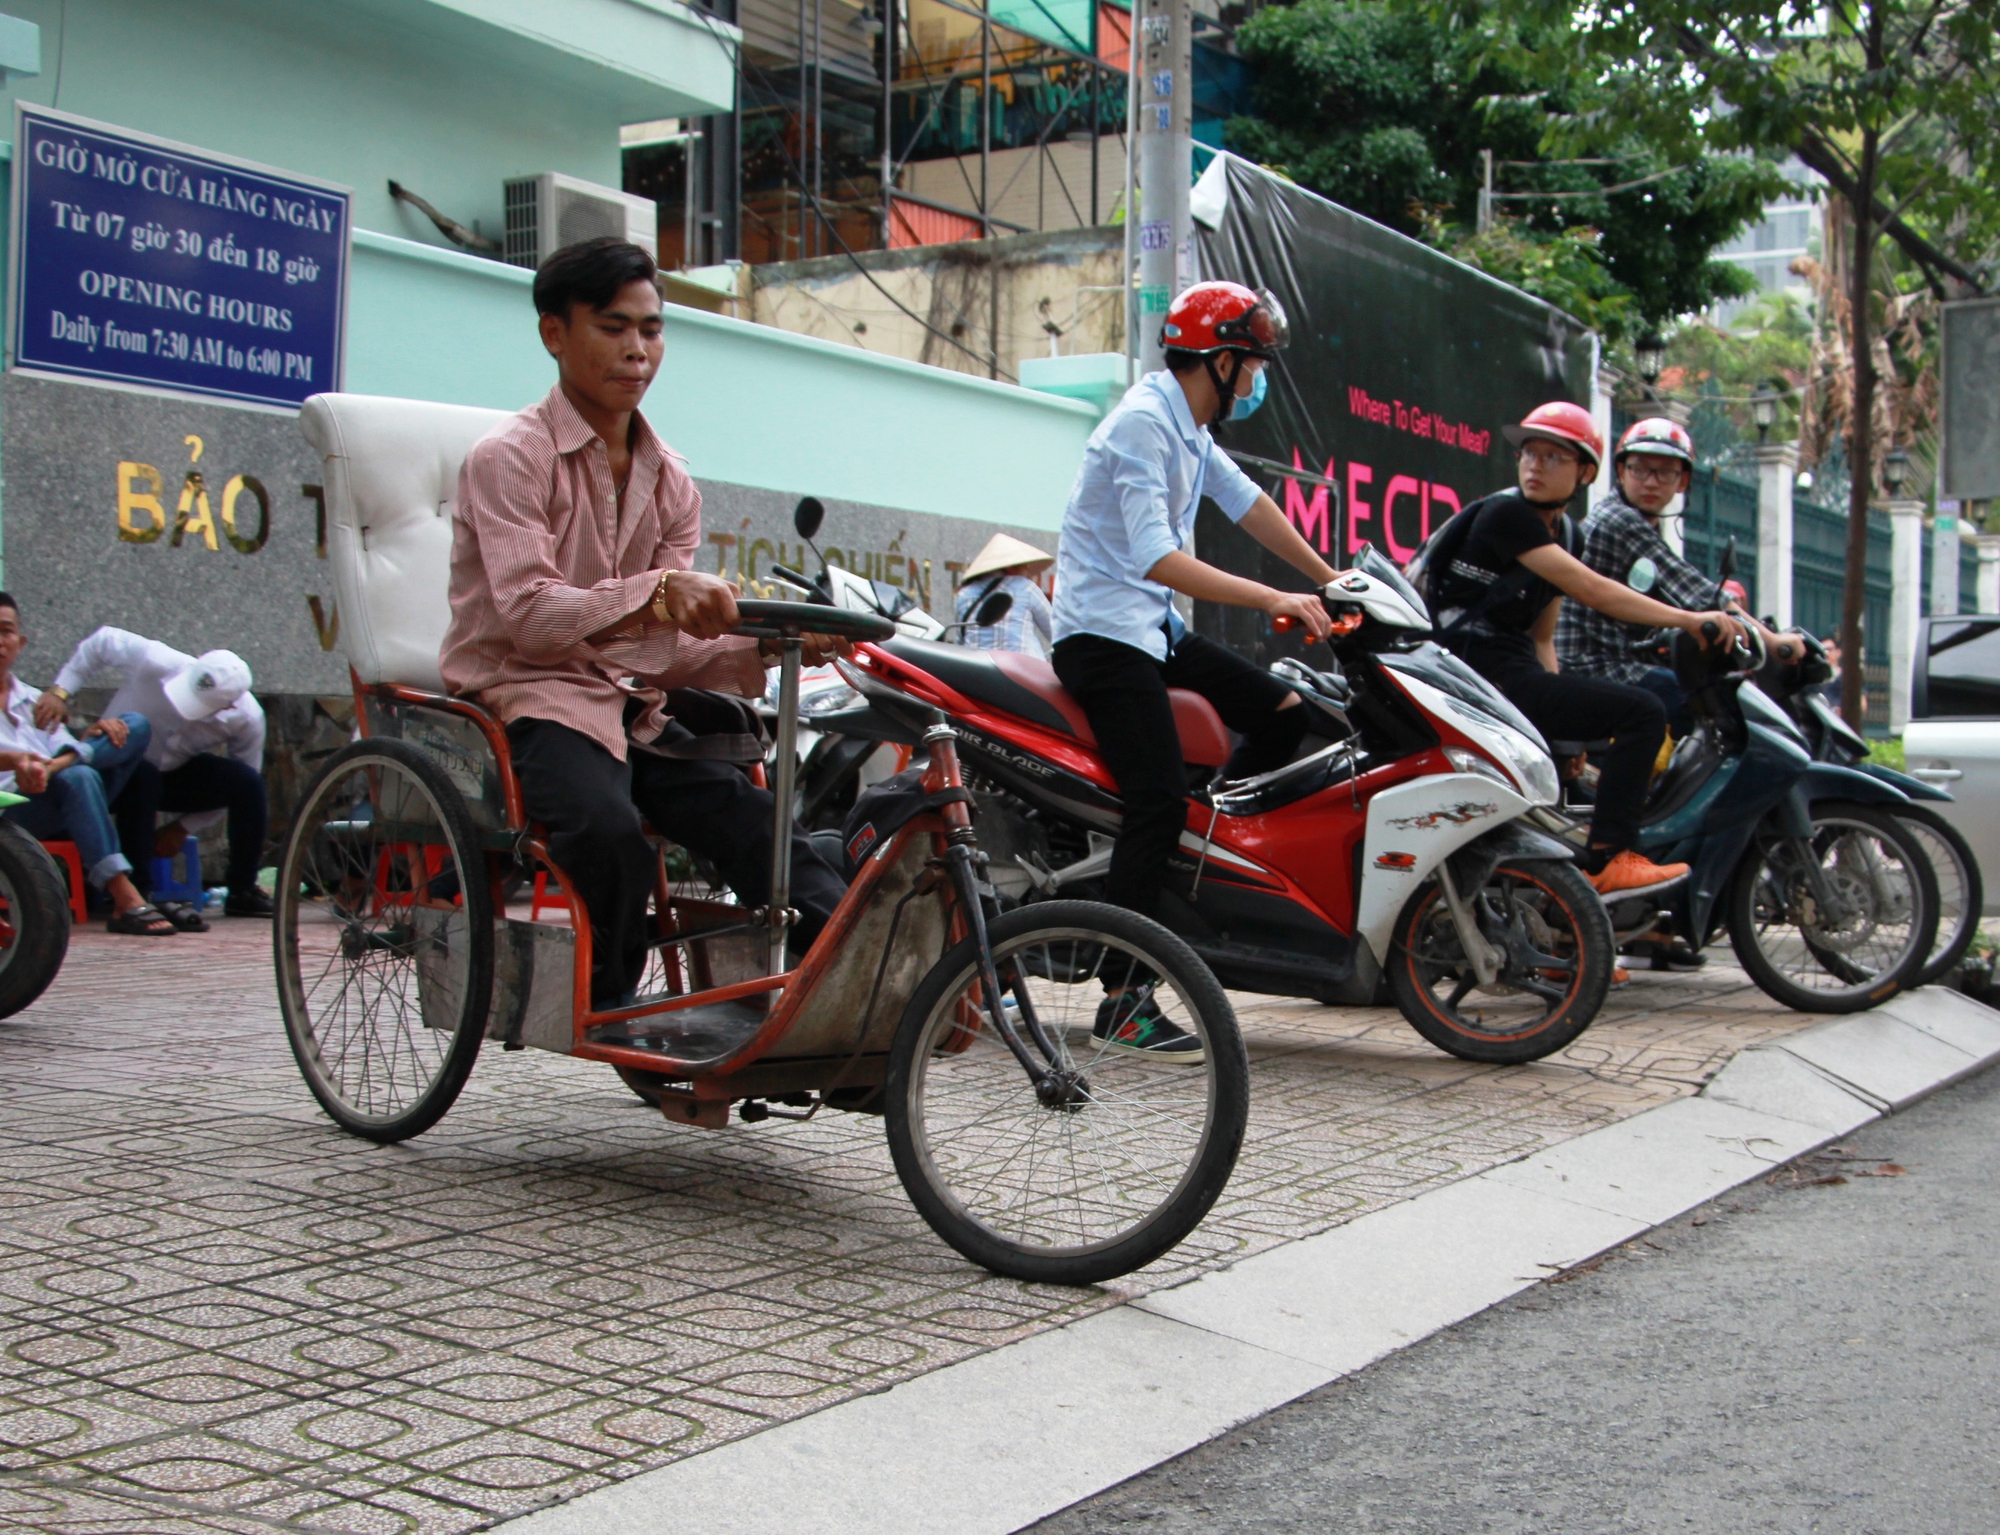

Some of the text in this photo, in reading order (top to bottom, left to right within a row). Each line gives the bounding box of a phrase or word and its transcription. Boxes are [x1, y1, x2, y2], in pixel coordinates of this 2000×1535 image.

[35, 139, 88, 173] GIỜ
[142, 163, 194, 200] CỬA
[199, 177, 267, 217] HÀNG
[271, 199, 336, 233] NGÀY
[51, 200, 320, 284] Từ 07 giờ 30 đến 18 giờ
[79, 269, 293, 332] OPENING HOURS
[51, 310, 313, 382] Daily from 7:30 AM to 6:00 PM
[1348, 385, 1391, 426] Where
[1393, 399, 1408, 432] To
[1410, 406, 1432, 438] Get
[1433, 413, 1457, 446] Your
[117, 435, 270, 555] BẢO
[708, 517, 805, 603] TÍCH
[987, 742, 1057, 779] BLADE
